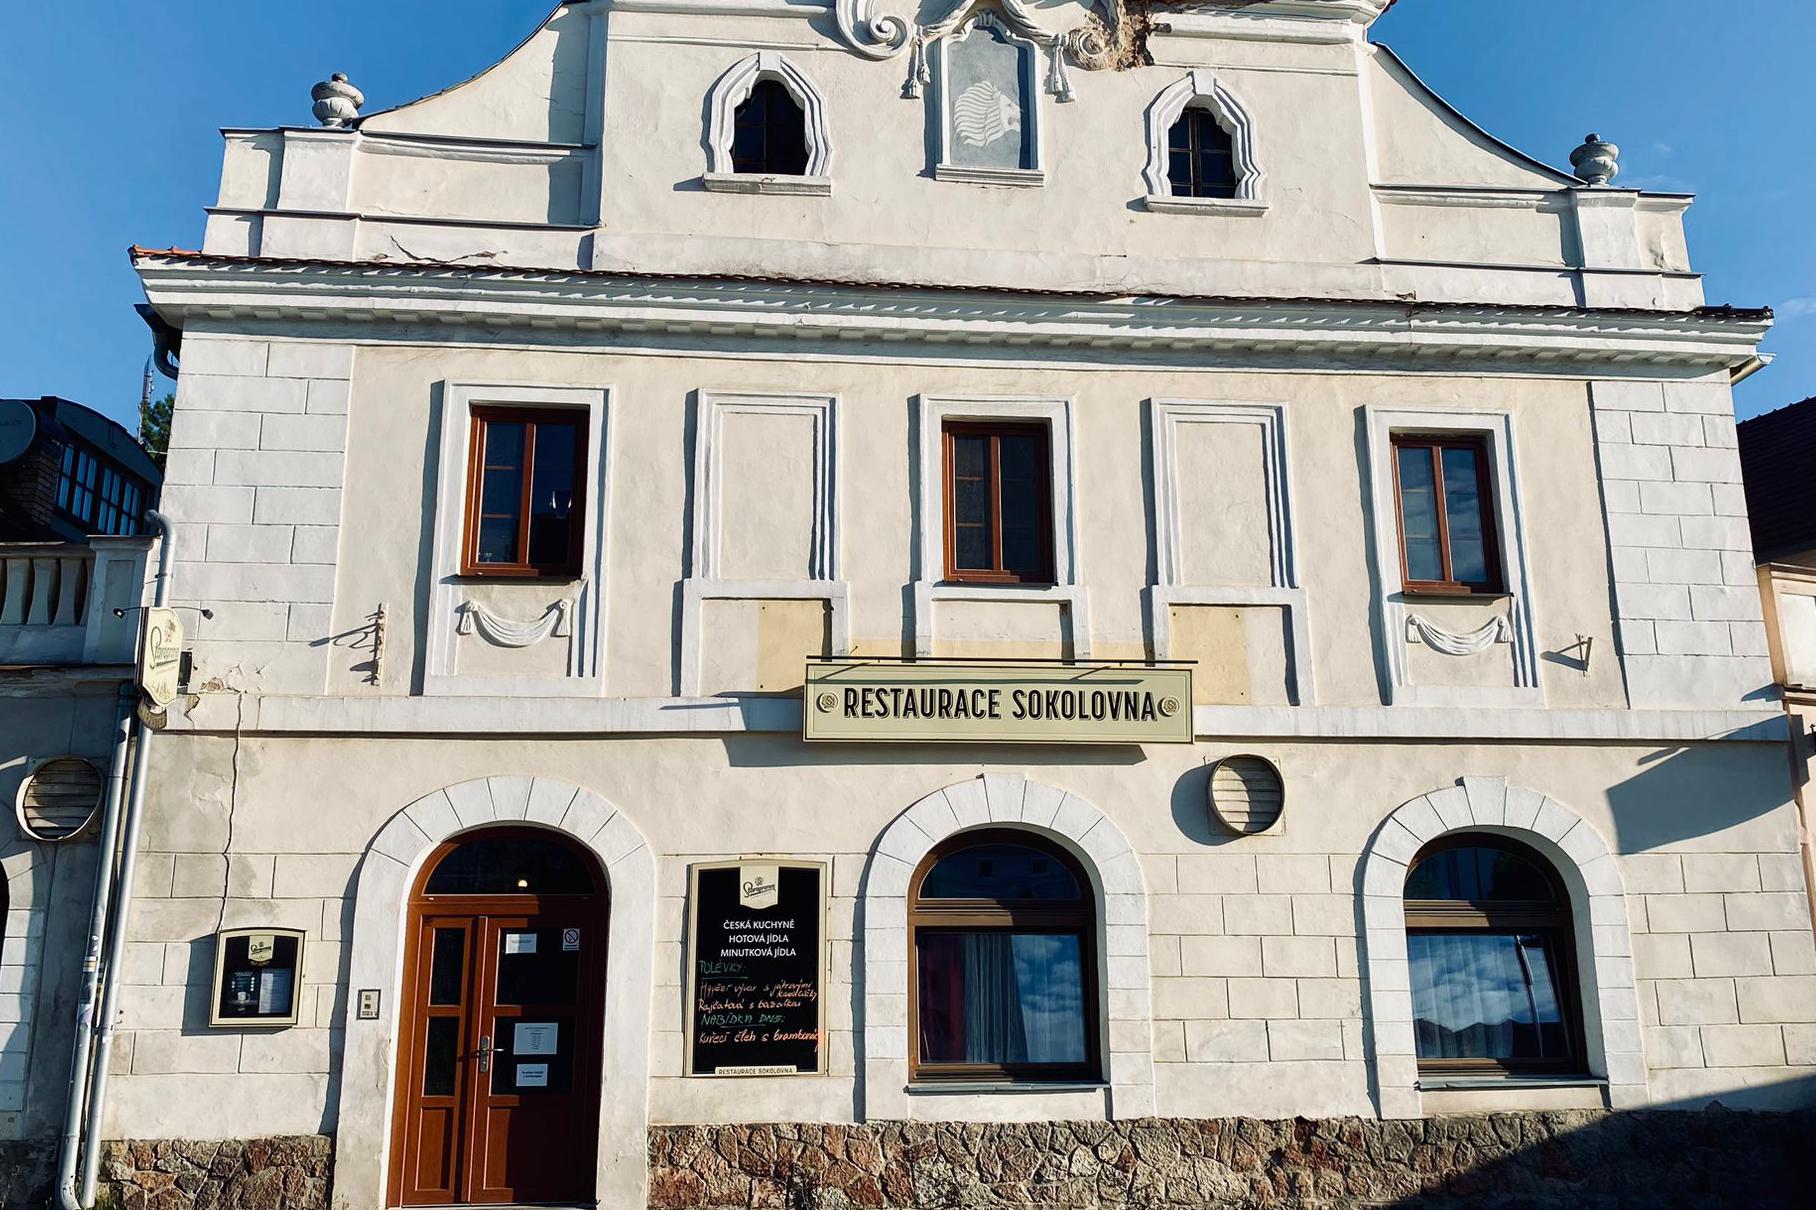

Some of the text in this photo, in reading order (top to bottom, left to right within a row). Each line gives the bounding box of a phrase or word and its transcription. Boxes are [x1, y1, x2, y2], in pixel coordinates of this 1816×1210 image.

[843, 687, 1157, 721] RESTAURACE SOKOLOVNA
[723, 919, 752, 930] ČESKÁ
[729, 932, 789, 944] HOTOVÁ JÍDLA
[720, 946, 796, 958] MINUTKOVÁ JÍDLA
[758, 1067, 793, 1075] SOKOLOVNA
